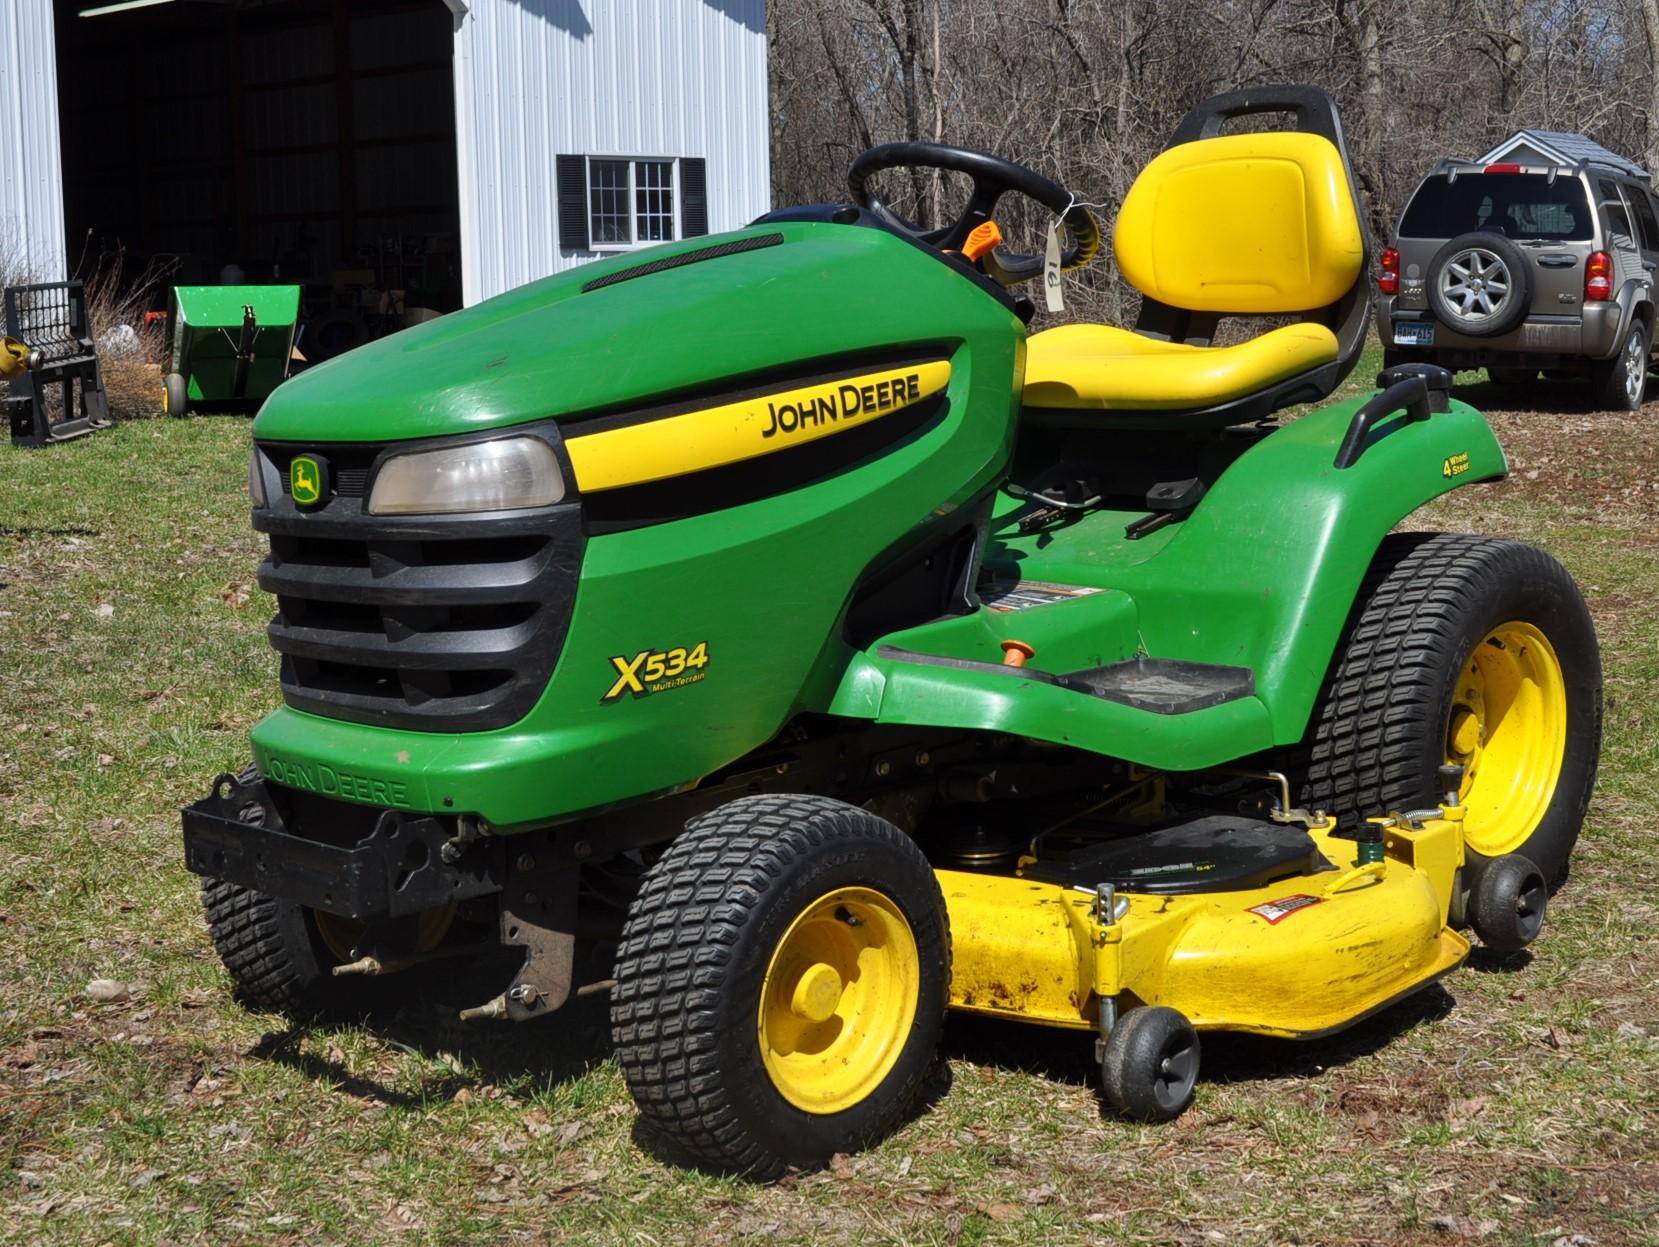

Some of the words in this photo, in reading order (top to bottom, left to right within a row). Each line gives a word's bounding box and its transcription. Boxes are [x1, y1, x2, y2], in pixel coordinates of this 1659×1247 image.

[762, 394, 837, 438] JOHN
[839, 374, 920, 419] DEERE
[1443, 459, 1452, 477] 4
[603, 640, 709, 700] X534
[262, 750, 317, 791] JOHN
[317, 763, 410, 807] DEERE
